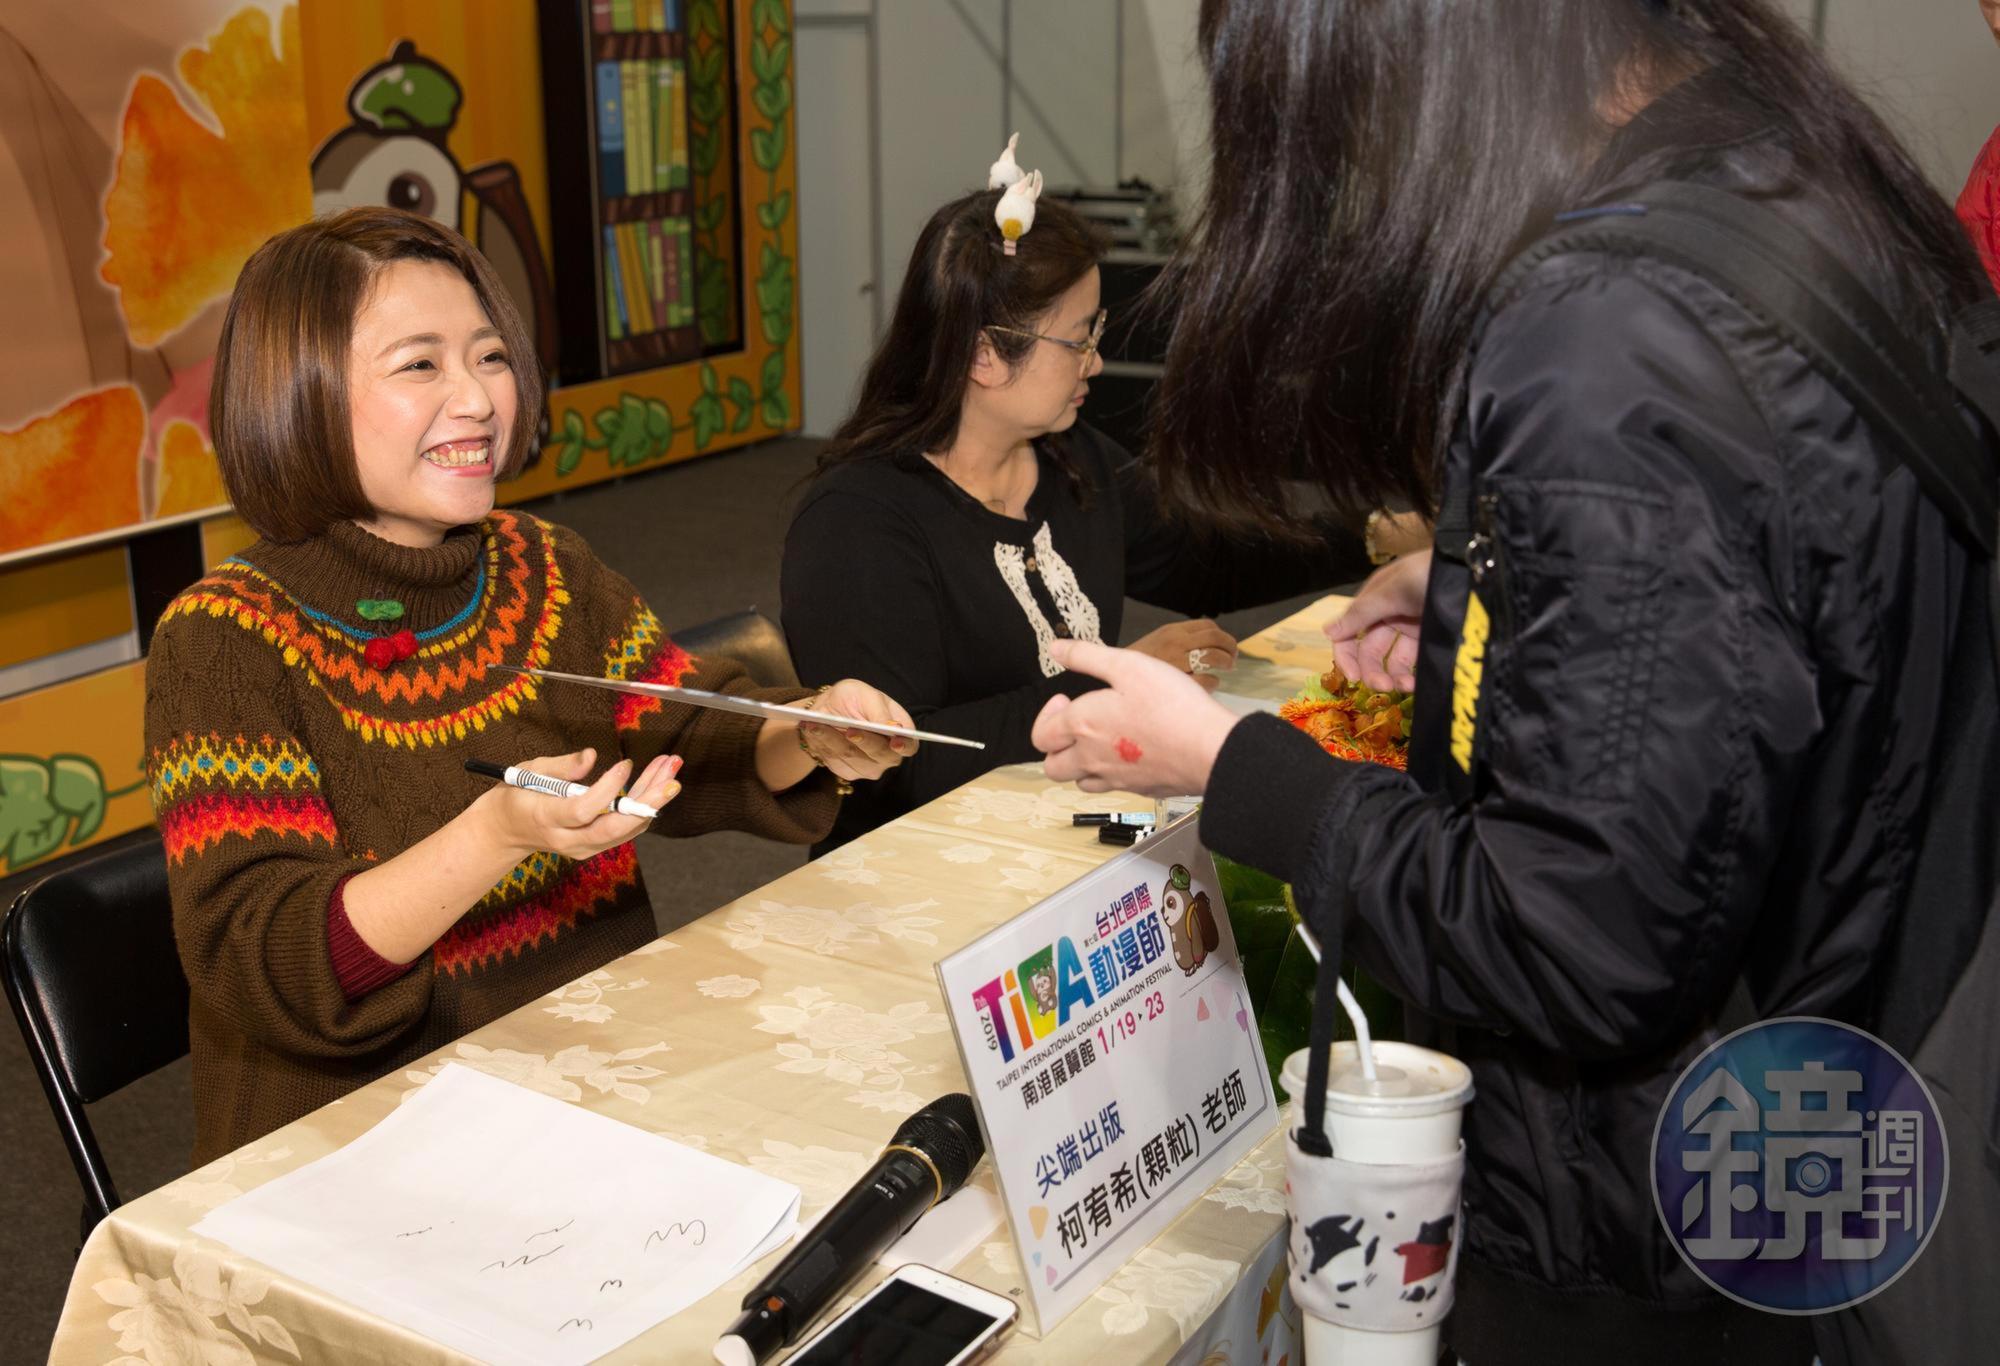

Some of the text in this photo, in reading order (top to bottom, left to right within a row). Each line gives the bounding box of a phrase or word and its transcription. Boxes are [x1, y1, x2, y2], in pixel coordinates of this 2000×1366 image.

[1096, 882, 1153, 939] 台北國際
[1088, 911, 1165, 999] 動漫節
[981, 1013, 998, 1051] 2019
[997, 963, 1172, 1091] TAIPEI INTERNATIONAL COMICS & ANIMATION FESTIVAL
[1021, 1038, 1096, 1109] 南港展覽館
[1036, 1100, 1125, 1199] 尖端出版
